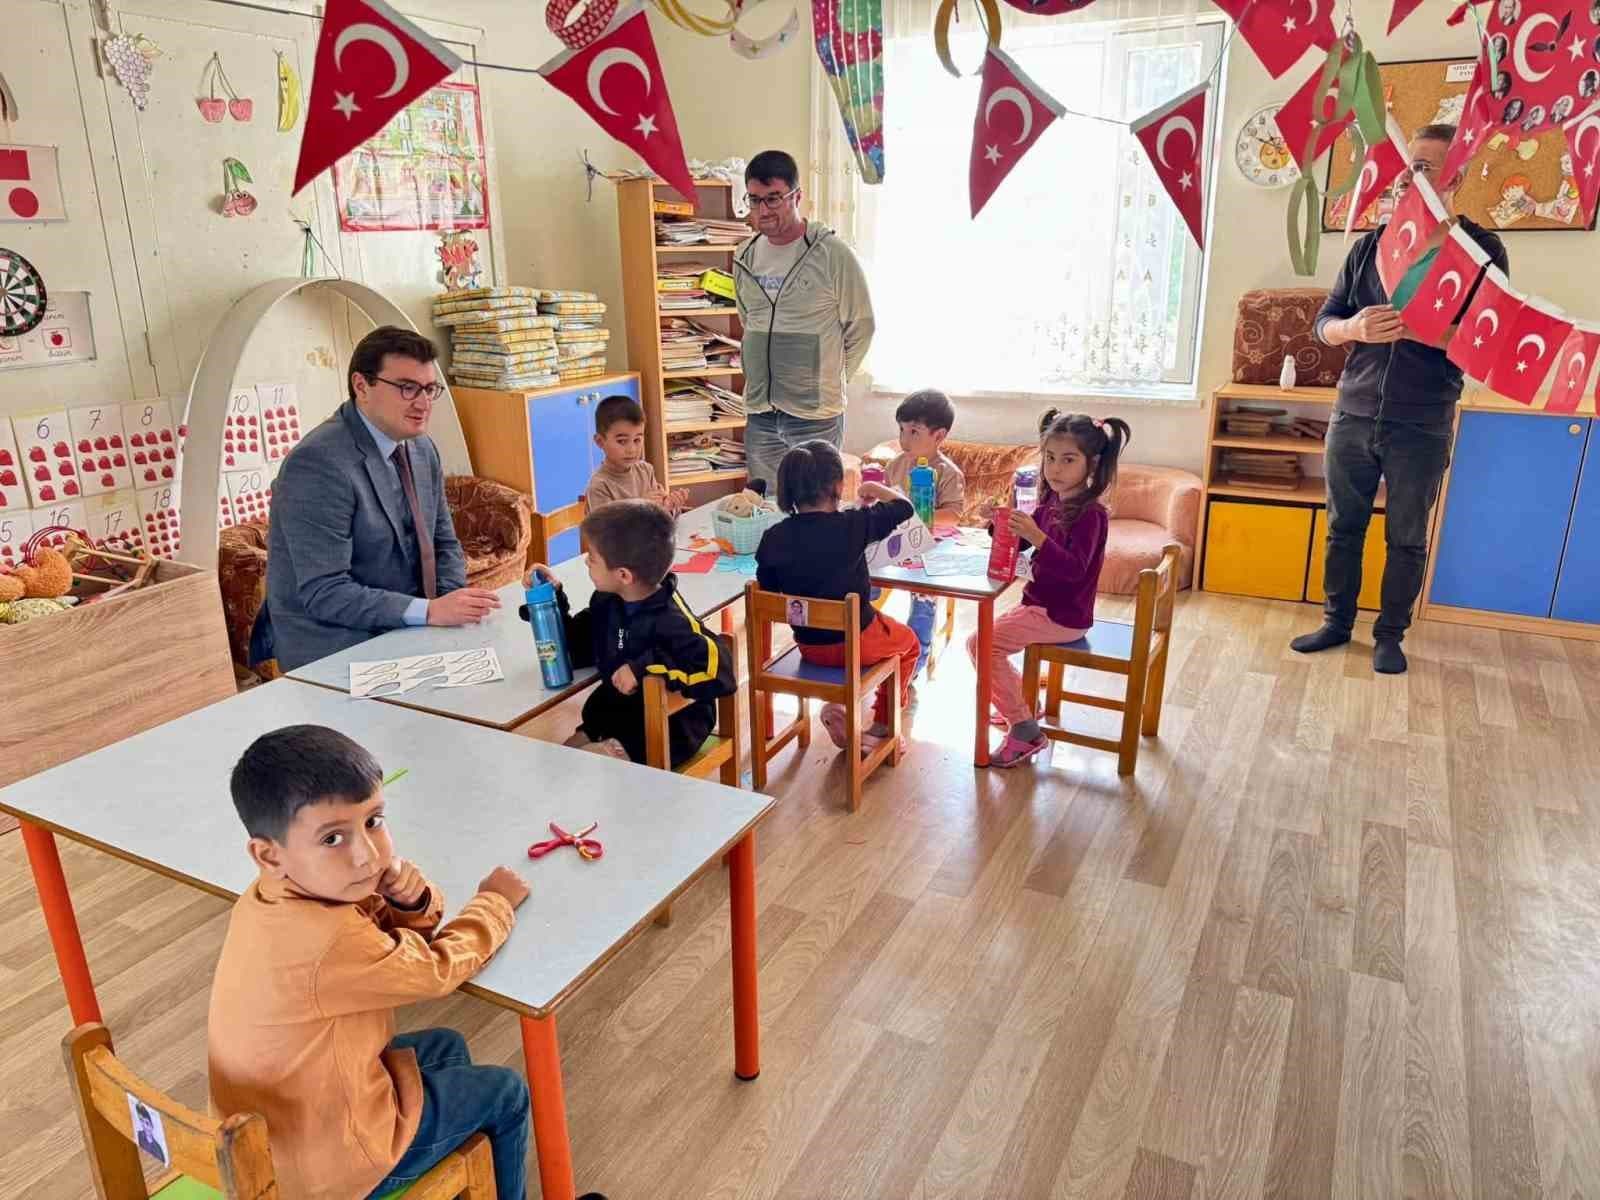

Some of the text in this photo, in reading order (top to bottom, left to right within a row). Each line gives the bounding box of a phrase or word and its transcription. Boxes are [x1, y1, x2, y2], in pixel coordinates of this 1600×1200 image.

[232, 394, 249, 413] 10
[273, 387, 284, 404] 11
[89, 409, 102, 430] 7
[140, 406, 153, 426] 8
[36, 417, 50, 439] 6
[239, 472, 262, 493] 20
[153, 489, 172, 510] 18
[49, 507, 70, 527] 16
[104, 510, 123, 534] 17
